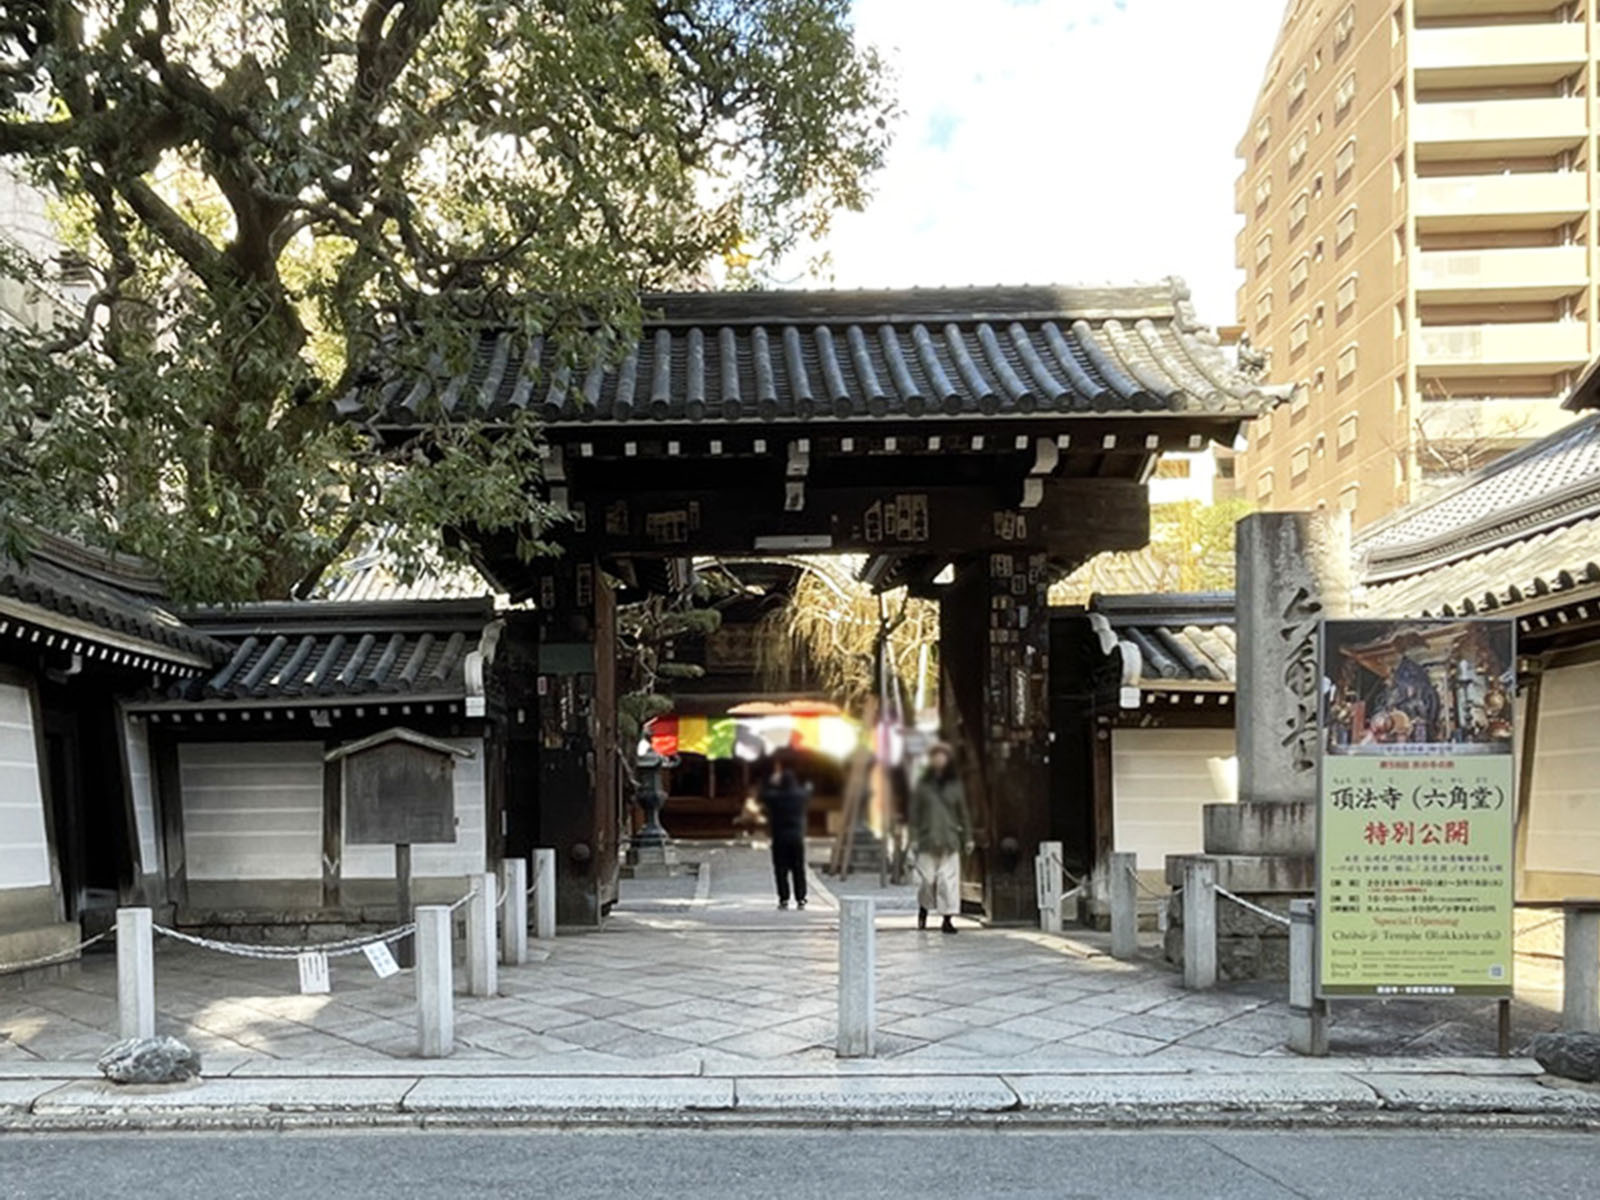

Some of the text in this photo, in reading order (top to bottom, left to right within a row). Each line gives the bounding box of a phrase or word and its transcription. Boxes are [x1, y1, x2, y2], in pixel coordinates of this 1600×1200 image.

[1364, 819, 1470, 846] 特別公開
[1373, 916, 1460, 928] Special Opening
[1383, 930, 1421, 942] Temple
